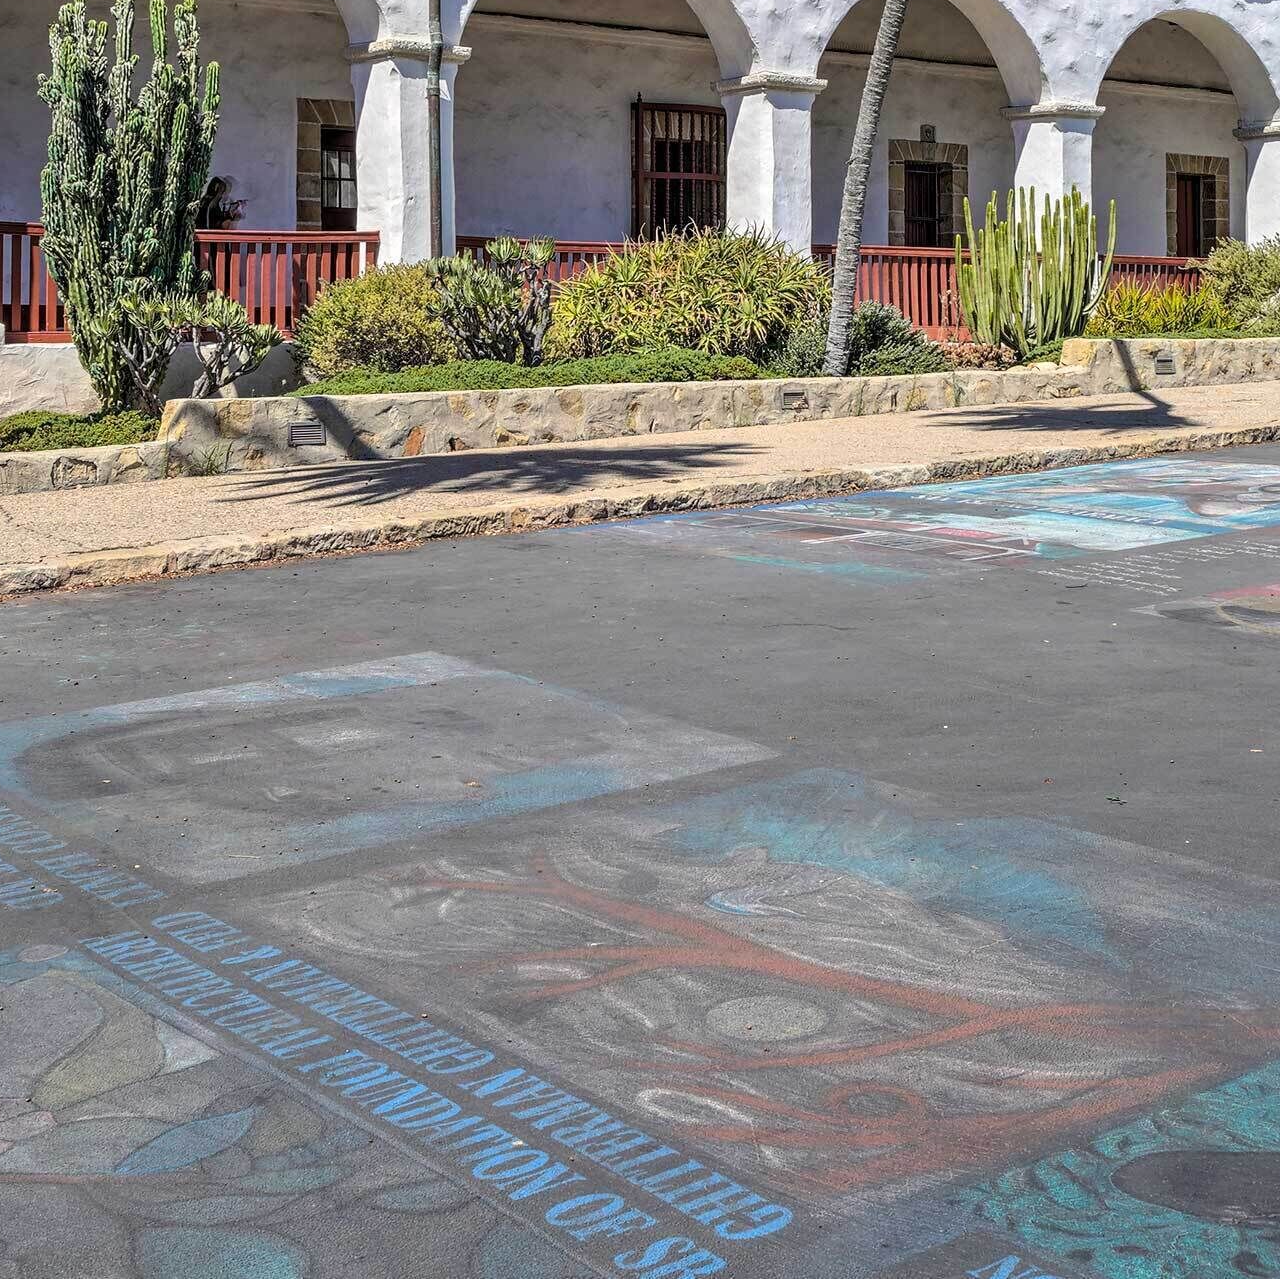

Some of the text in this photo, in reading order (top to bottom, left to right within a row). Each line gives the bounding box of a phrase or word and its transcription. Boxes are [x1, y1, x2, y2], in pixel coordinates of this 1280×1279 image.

[150, 911, 246, 952] FELD
[76, 928, 339, 1058] ARCHITECTURAL
[296, 1048, 587, 1202] FOUNDATION
[543, 1192, 657, 1242] OF
[246, 959, 496, 1075] GHITTERMAN
[458, 1067, 795, 1241] GHITTERMAN
